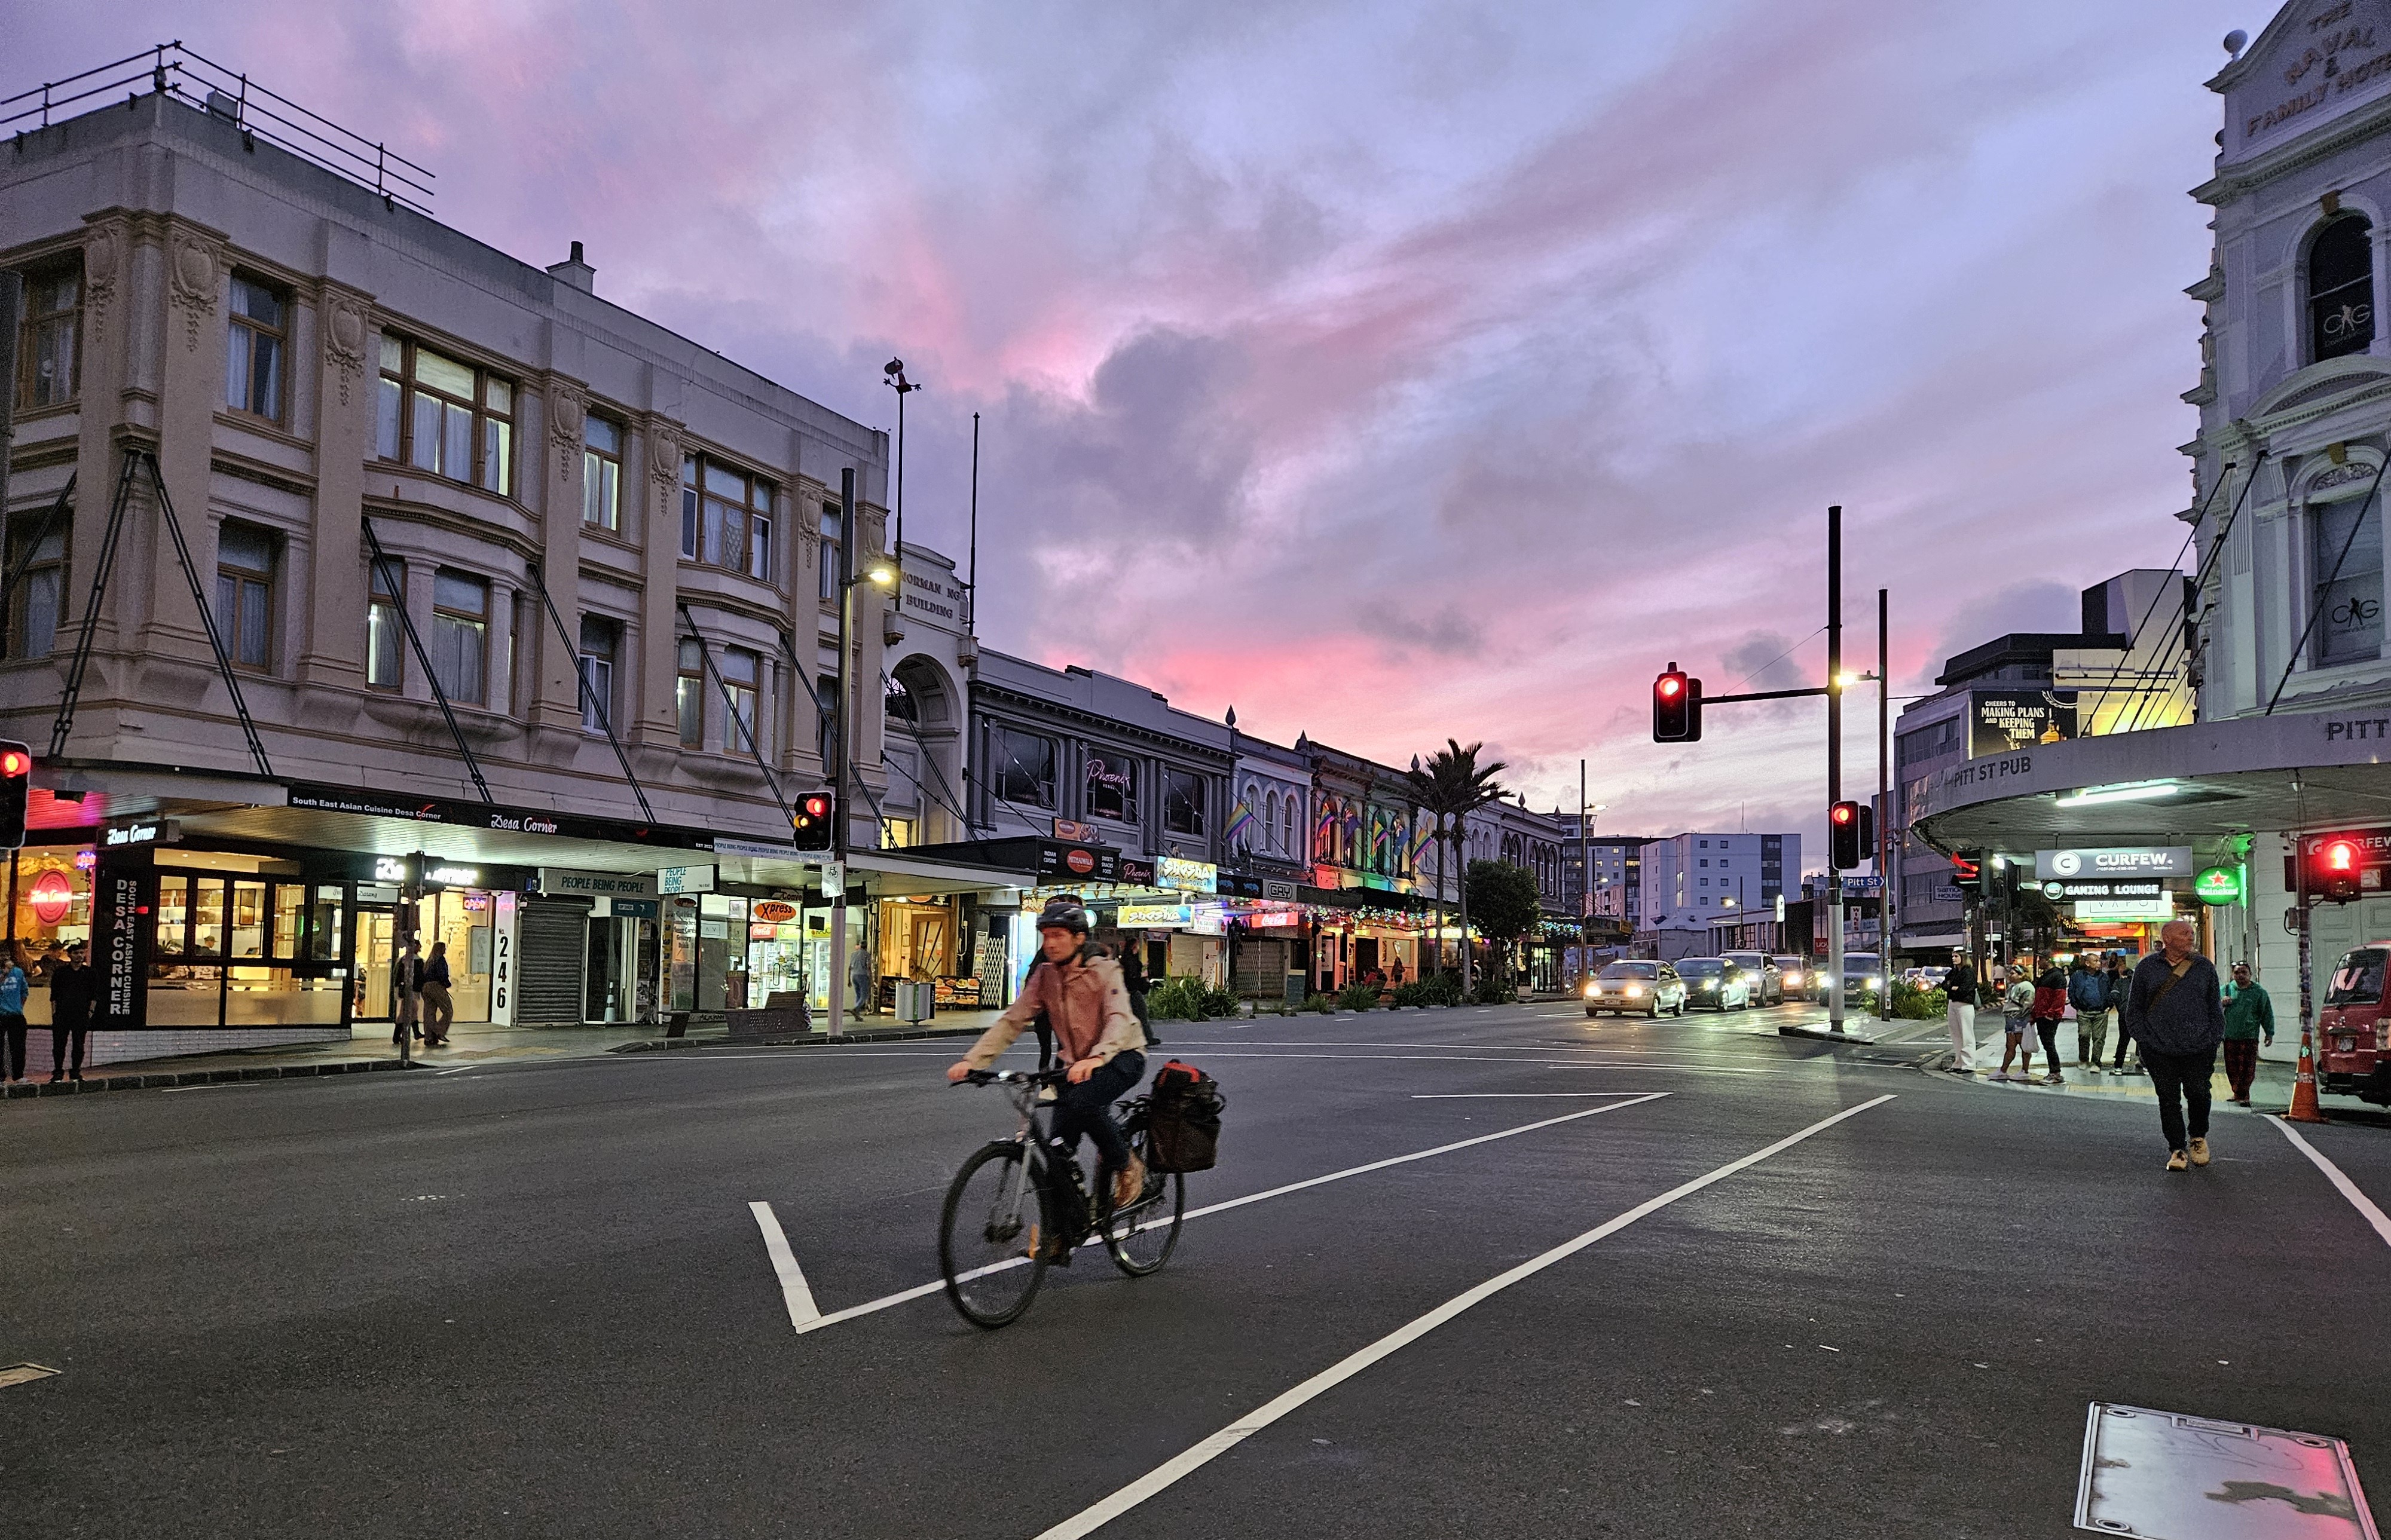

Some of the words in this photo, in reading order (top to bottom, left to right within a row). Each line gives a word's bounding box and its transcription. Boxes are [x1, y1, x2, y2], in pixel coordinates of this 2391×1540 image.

[901, 572, 941, 594] NORMAN
[947, 587, 961, 601] NG
[906, 594, 953, 619] BUILDING
[1981, 707, 2016, 718] MAKING
[2017, 707, 2045, 718] PLANS
[1998, 718, 2035, 728] KEEPING
[2009, 728, 2035, 739] THEM
[2328, 718, 2390, 741] PITT
[1954, 767, 1976, 788] PITT
[1979, 763, 1996, 780] ST
[2000, 757, 2031, 777] PUB
[292, 796, 317, 807] South
[319, 799, 338, 809] East
[340, 801, 362, 812] Asian
[364, 804, 393, 815] Cuisine
[395, 808, 414, 818] Desa
[416, 810, 441, 820] Corner
[491, 815, 520, 829] Desa
[524, 818, 557, 834] Corner
[665, 876, 682, 886] BEING
[1124, 863, 1151, 881] Phoenix
[561, 876, 591, 889] PEOPLE
[592, 878, 616, 891] BEING
[617, 880, 644, 893] PEOPLE
[1270, 885, 1291, 897] GAY
[2065, 884, 2109, 895] GAMING
[2114, 884, 2160, 895] LOUNGE
[114, 879, 128, 930] DESA
[127, 880, 137, 914] SOUTH
[760, 903, 793, 921] Xpress
[126, 916, 135, 941] EAST
[124, 942, 133, 973] ASIAN
[110, 936, 125, 1015] CORNER
[497, 936, 509, 1009] 246
[122, 975, 132, 1015] CUISINE
